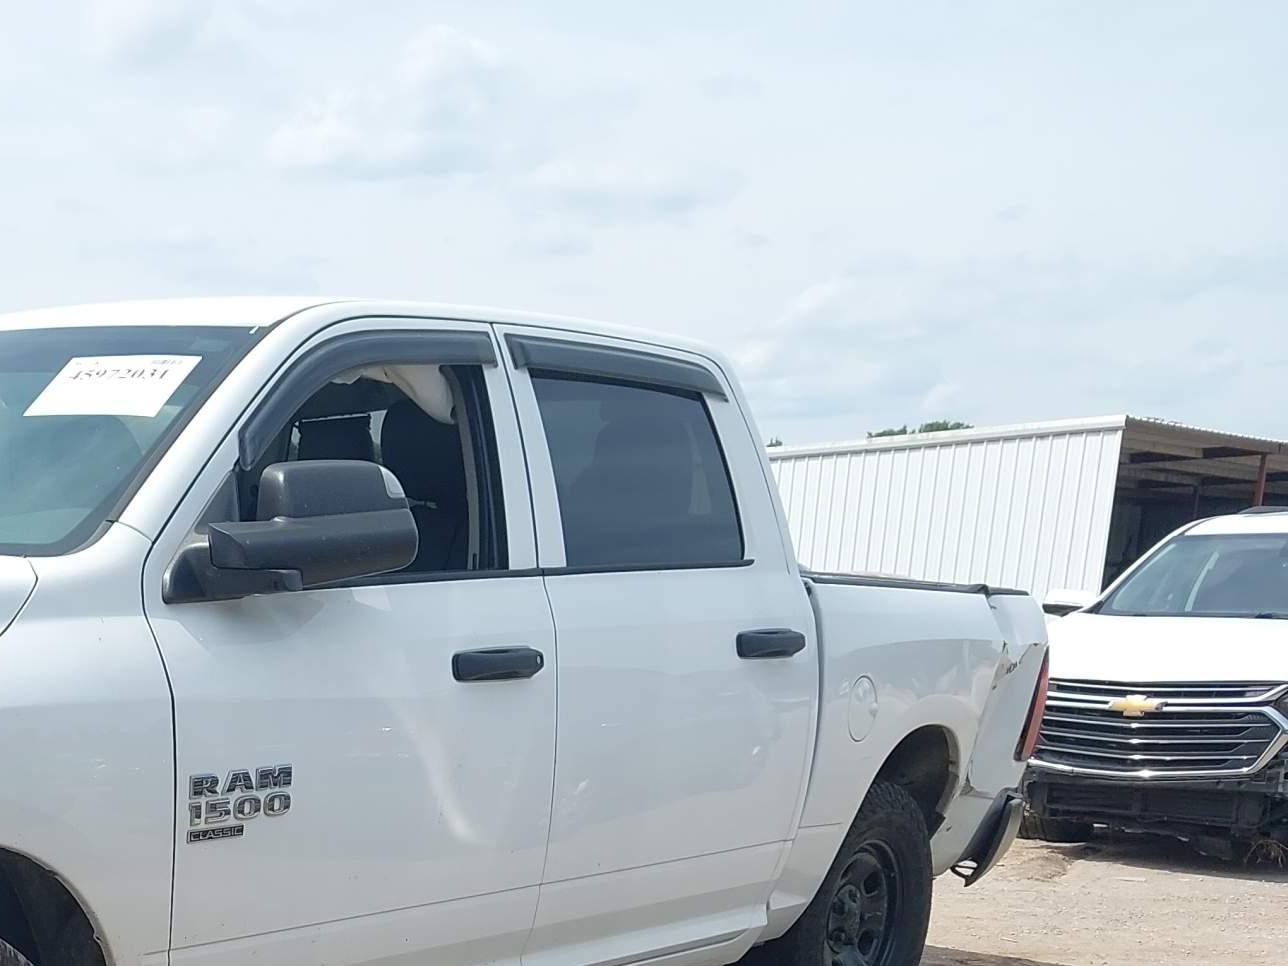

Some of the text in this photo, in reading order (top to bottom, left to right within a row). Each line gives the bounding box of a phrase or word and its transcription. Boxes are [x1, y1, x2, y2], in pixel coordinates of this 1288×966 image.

[189, 764, 293, 800] RAM
[189, 791, 291, 826] 1500
[189, 825, 244, 842] CLASSIC
